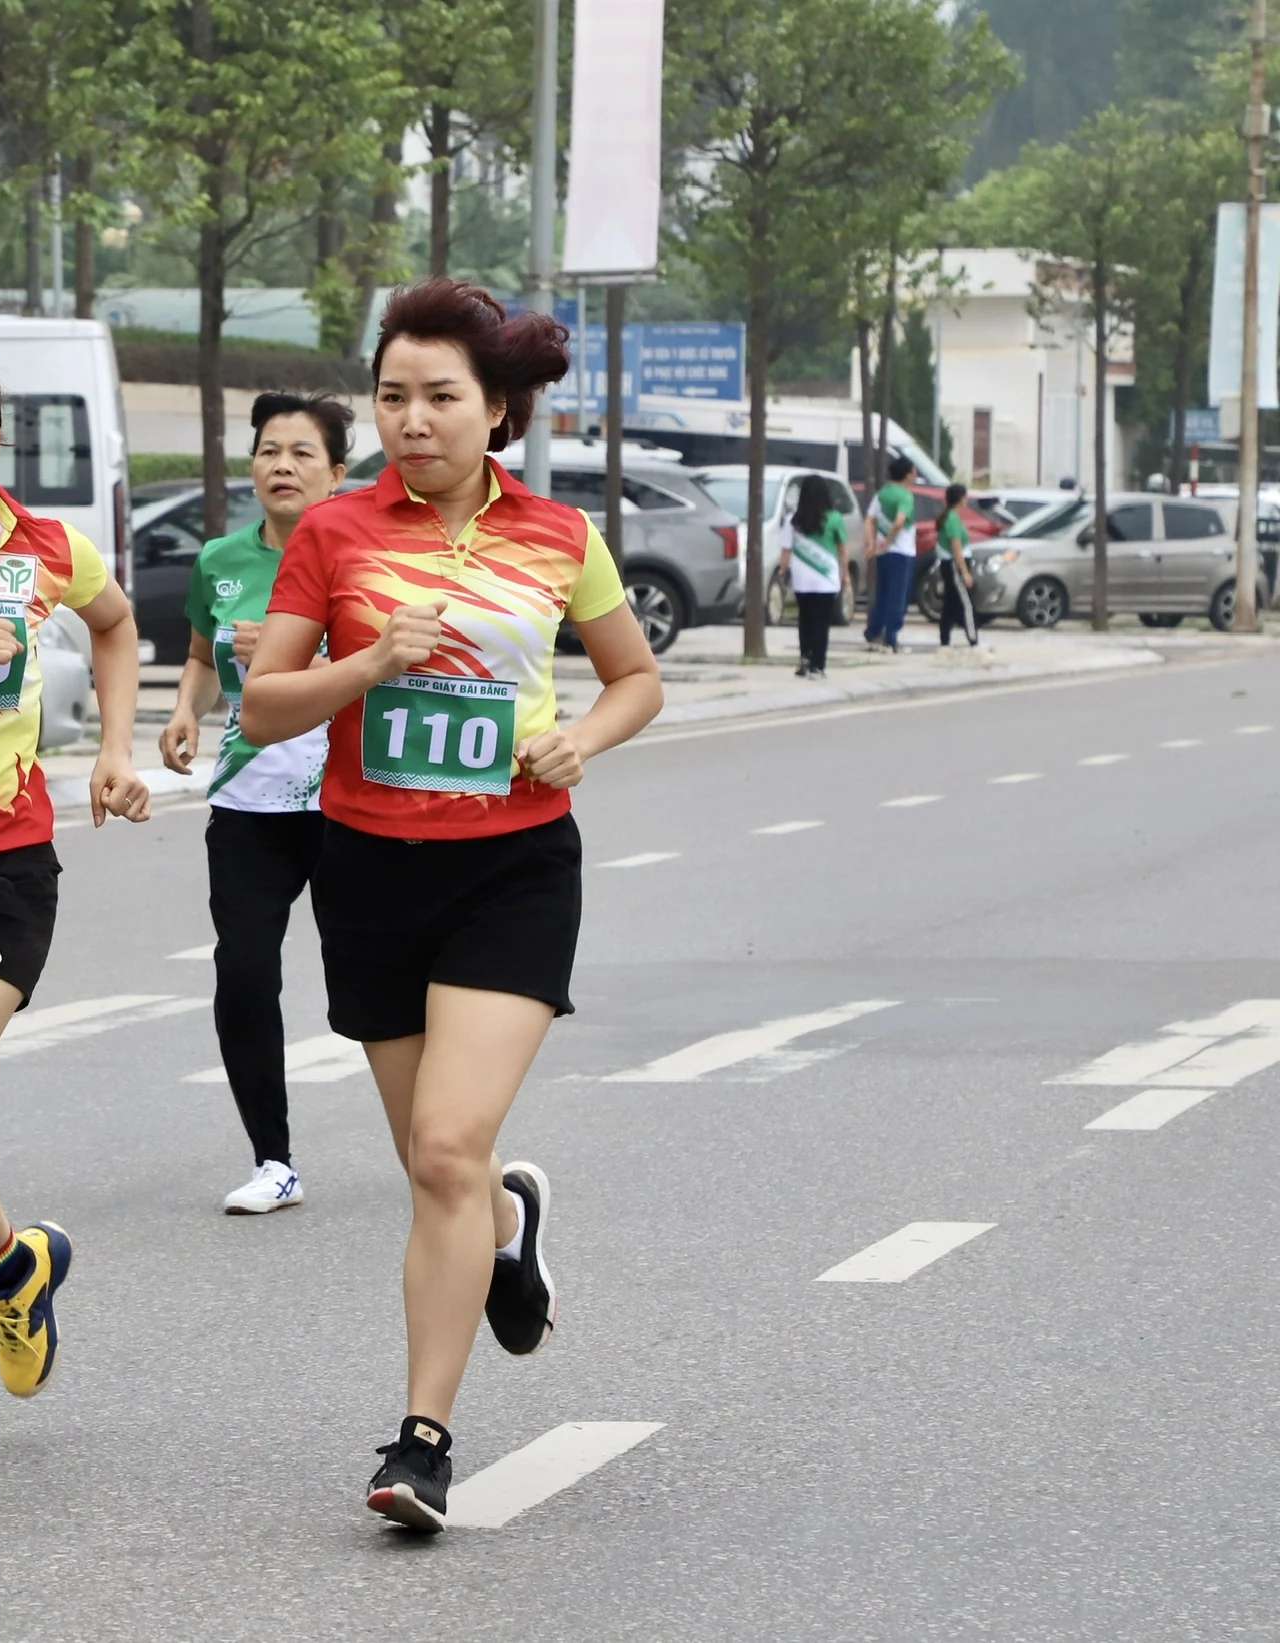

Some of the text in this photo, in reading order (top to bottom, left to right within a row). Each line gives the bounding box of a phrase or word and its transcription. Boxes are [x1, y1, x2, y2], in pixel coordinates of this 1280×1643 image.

[408, 677, 429, 688] CÚP
[432, 680, 456, 693] GIẤY
[459, 683, 477, 695] BÃI
[480, 683, 508, 696] BẰNG
[382, 707, 499, 769] 110
